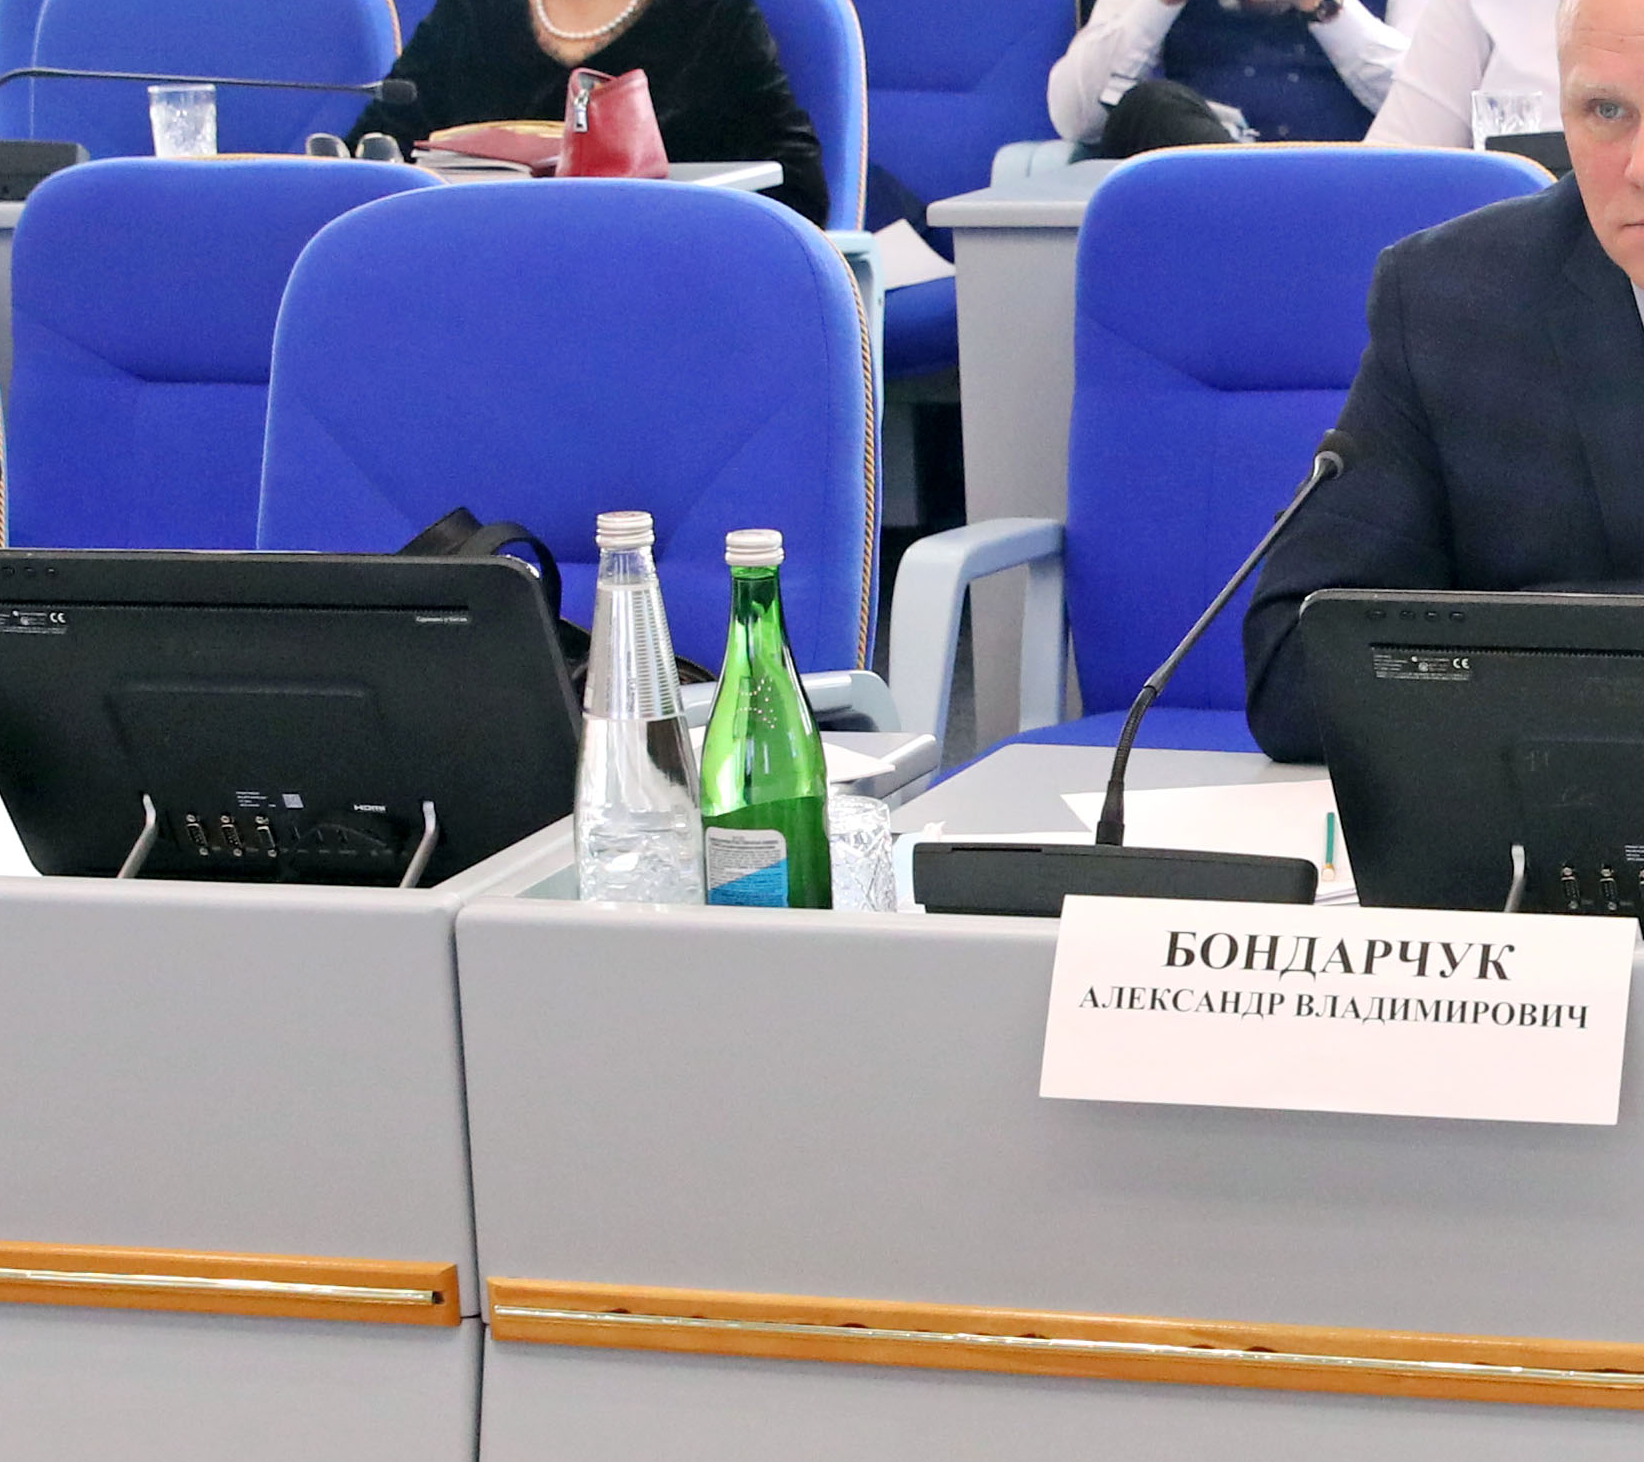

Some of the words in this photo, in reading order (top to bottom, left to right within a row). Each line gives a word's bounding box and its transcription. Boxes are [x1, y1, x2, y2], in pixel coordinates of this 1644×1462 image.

[1161, 930, 1516, 982] БОНДАРЧУК
[1078, 985, 1285, 1026] АЛЕКСАНДР
[1293, 993, 1589, 1029] ВЛАДИМИРОВИЧ
